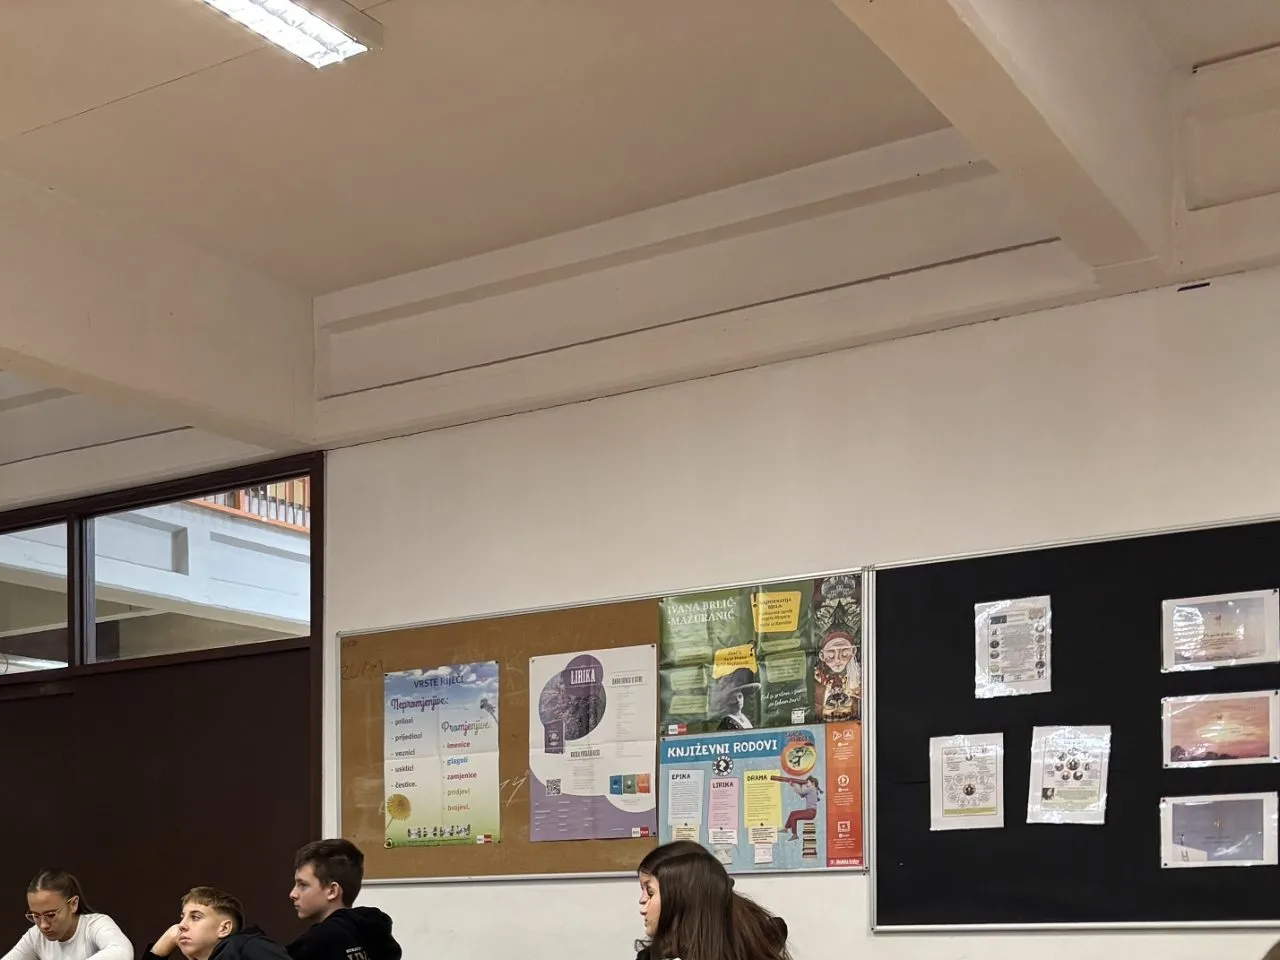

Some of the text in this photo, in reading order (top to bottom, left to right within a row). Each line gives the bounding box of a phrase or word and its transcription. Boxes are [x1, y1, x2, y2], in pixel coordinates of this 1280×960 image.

[668, 602, 700, 614] IVANA
[414, 673, 464, 688] VRSTE RIJEČI
[570, 669, 596, 685] LIRIKA
[395, 717, 414, 726] prilozi
[395, 732, 422, 742] prijedlozi
[447, 741, 471, 749] imenice
[667, 739, 777, 758] KNJIŽEVNI RODOVI
[395, 749, 415, 757] veznici
[447, 757, 468, 766] glagoli
[395, 765, 414, 773] usklici
[447, 772, 477, 781] zamjenice
[447, 788, 470, 797] pridjevi
